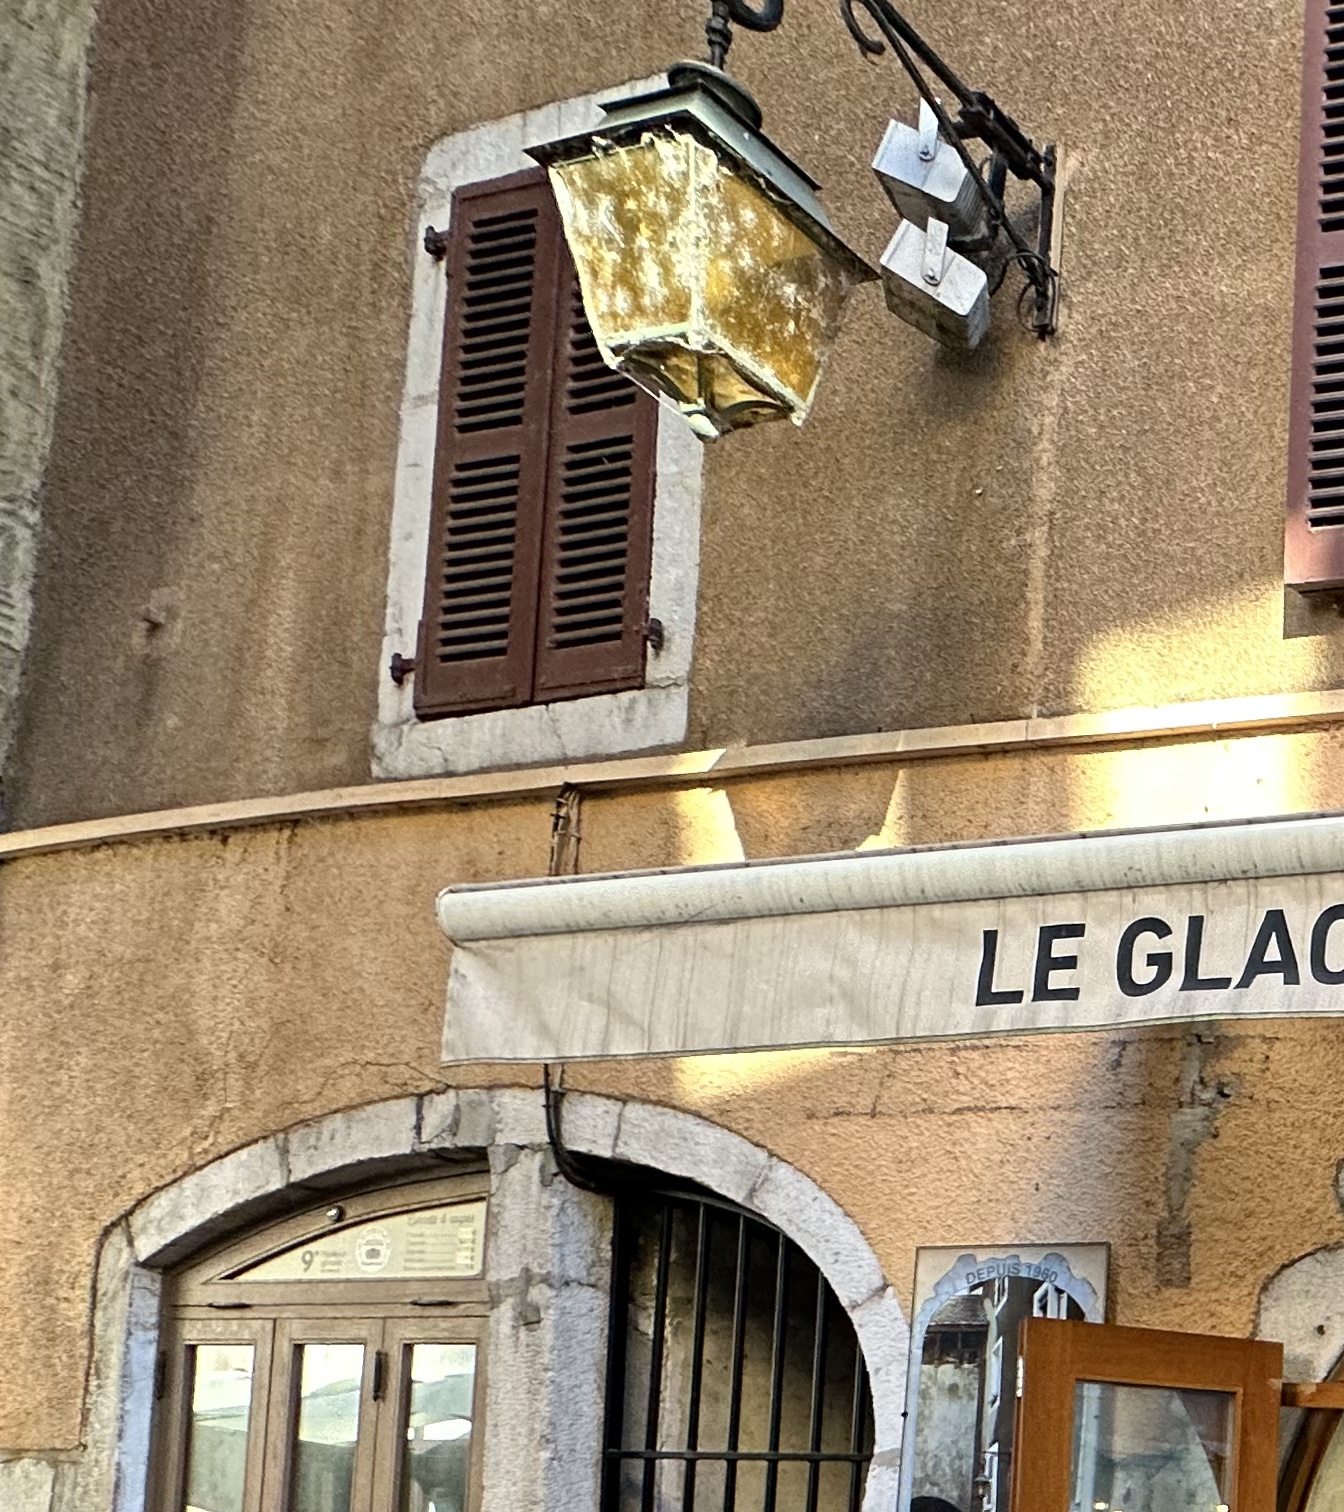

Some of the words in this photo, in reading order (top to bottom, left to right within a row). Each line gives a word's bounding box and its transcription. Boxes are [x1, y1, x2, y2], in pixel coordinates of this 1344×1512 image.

[977, 924, 1085, 1007] LE
[965, 1262, 1020, 1284] DEPUIS
[1025, 1264, 1058, 1284] 1960
